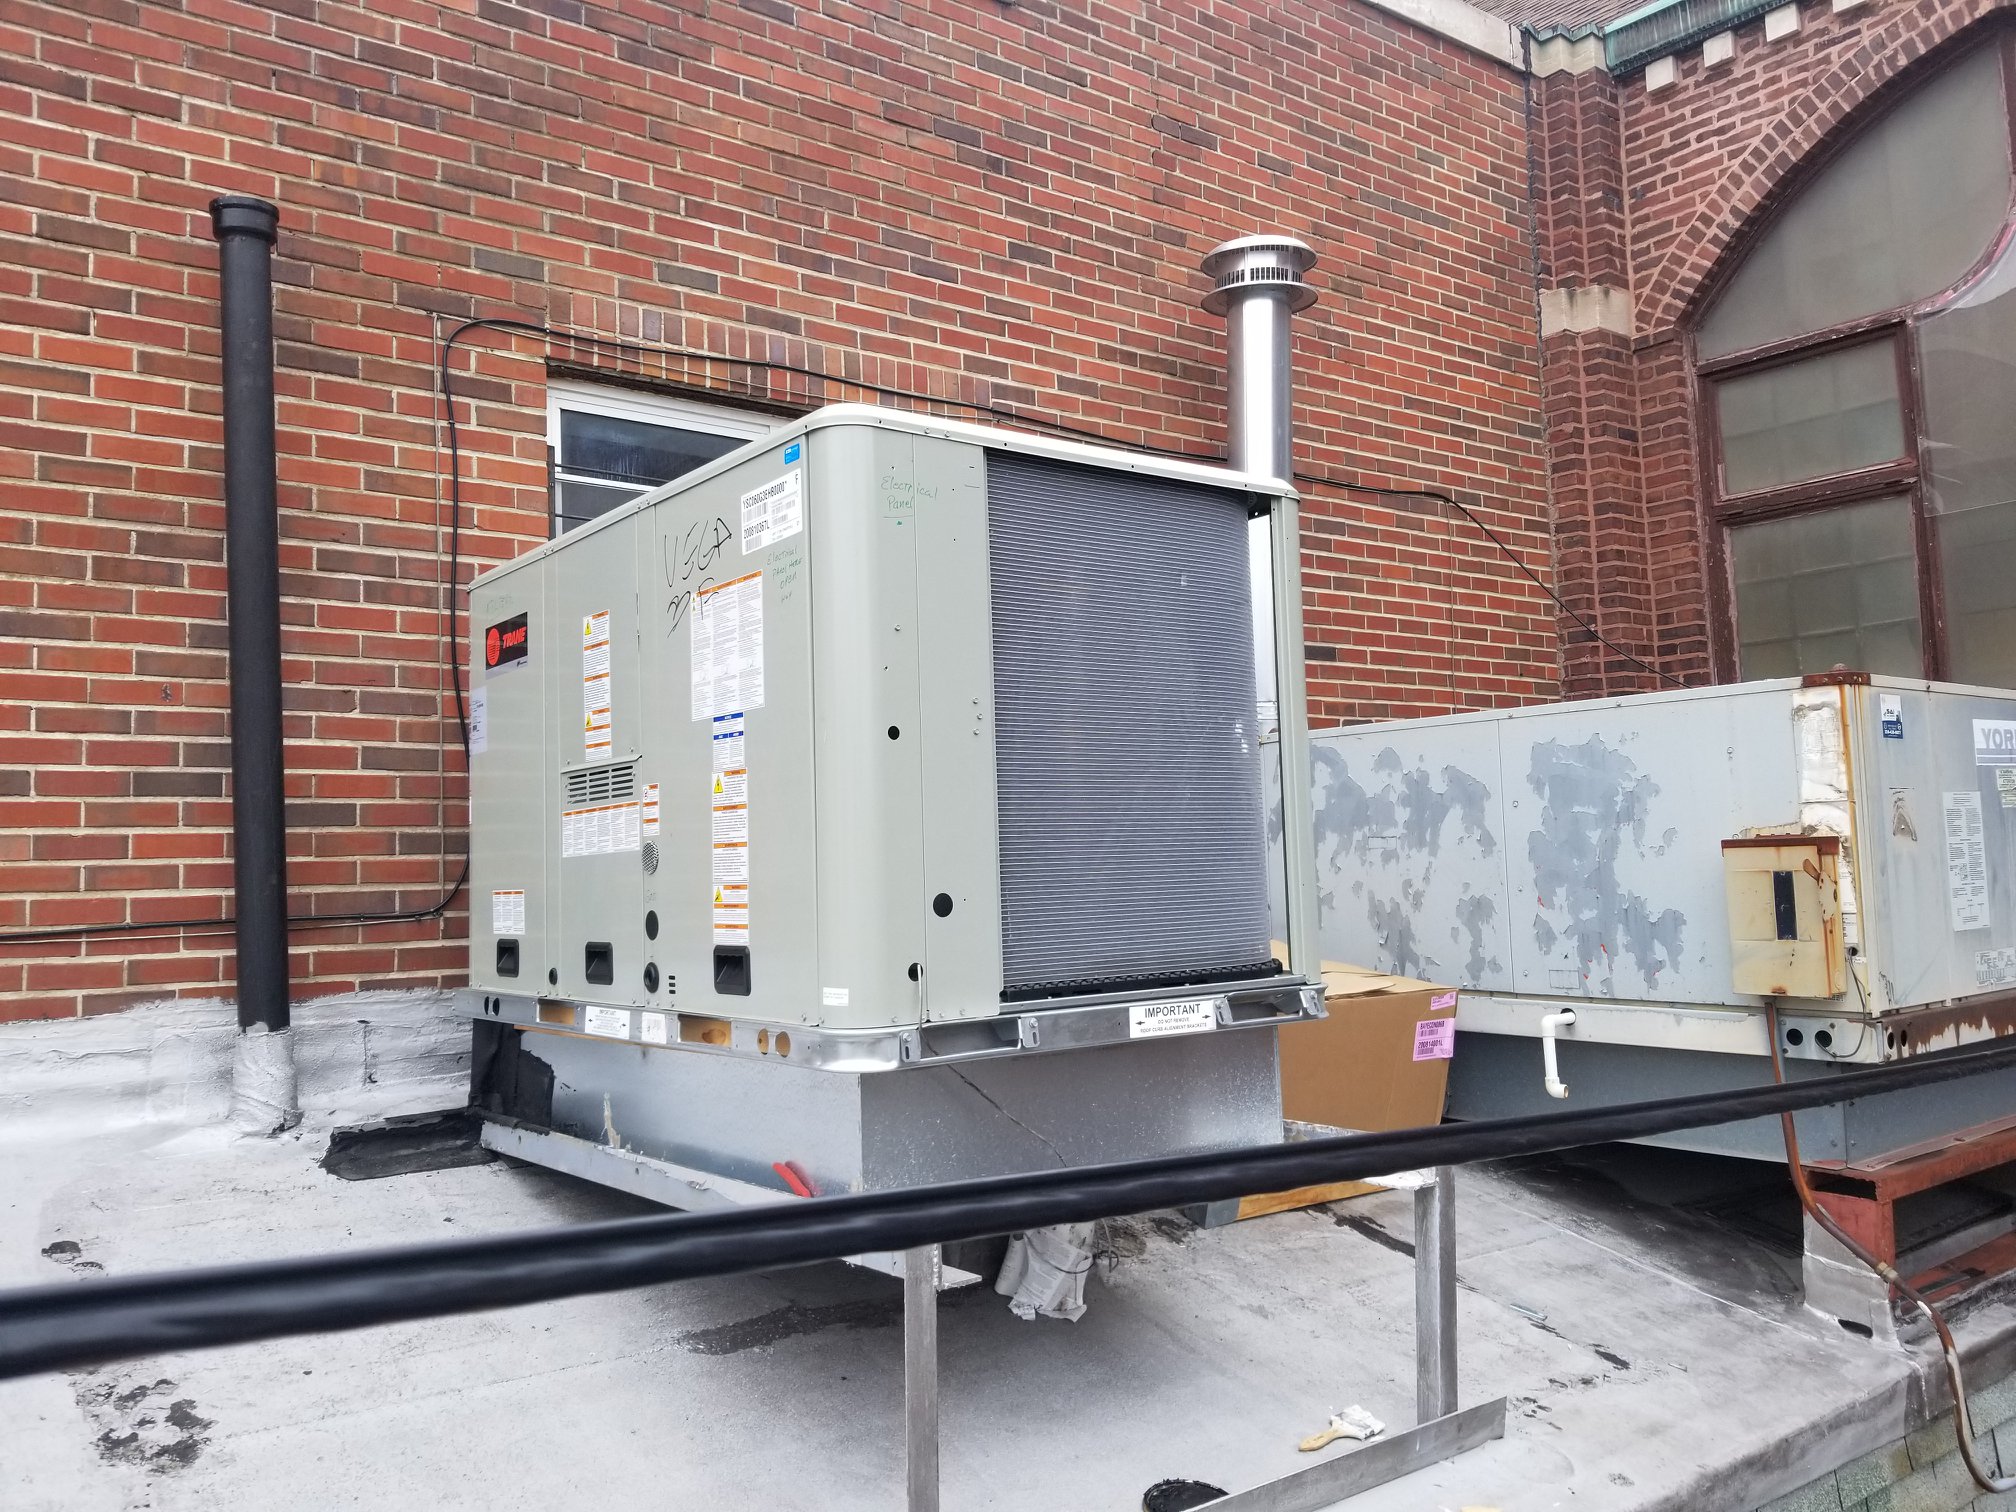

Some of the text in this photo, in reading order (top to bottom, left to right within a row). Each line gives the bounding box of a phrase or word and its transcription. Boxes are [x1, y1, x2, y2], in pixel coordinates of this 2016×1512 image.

[502, 625, 528, 649] TRANE
[1981, 727, 2016, 749] YOR
[1144, 1002, 1201, 1018] IMPORTANT
